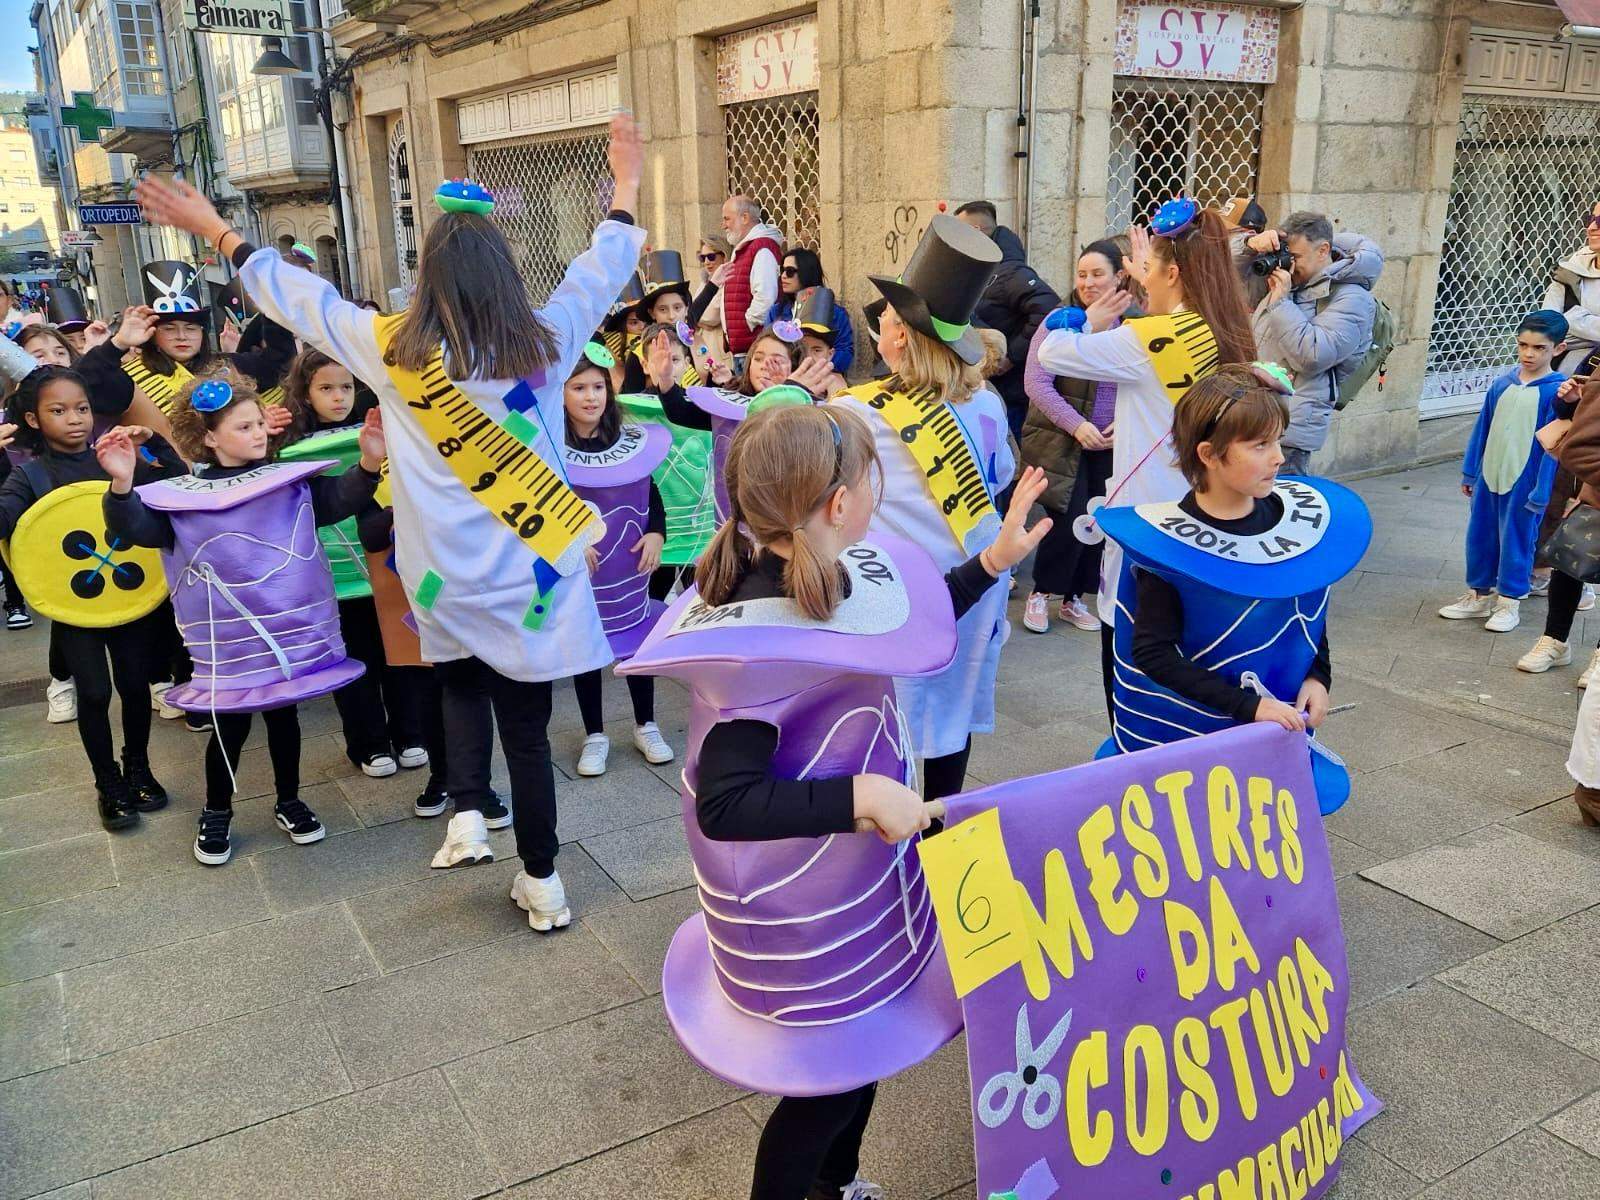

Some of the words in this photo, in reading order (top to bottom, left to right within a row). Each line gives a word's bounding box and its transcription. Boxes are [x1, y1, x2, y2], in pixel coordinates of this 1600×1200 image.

[753, 27, 801, 91] SV
[1156, 8, 1229, 70] SV
[80, 208, 140, 222] ORTOPEDIA
[437, 437, 462, 458] 8
[470, 471, 497, 493] 9
[501, 502, 545, 539] 10
[868, 391, 894, 410] 5
[901, 423, 923, 443] 6
[943, 493, 959, 516] 8
[847, 544, 894, 586] 100
[1159, 517, 1239, 557] 100%
[1258, 535, 1301, 558] LA
[956, 859, 991, 934] 6
[1016, 765, 1304, 1001] MESTRES
[1163, 875, 1261, 1001] DA
[1066, 937, 1335, 1167] COSTURA
